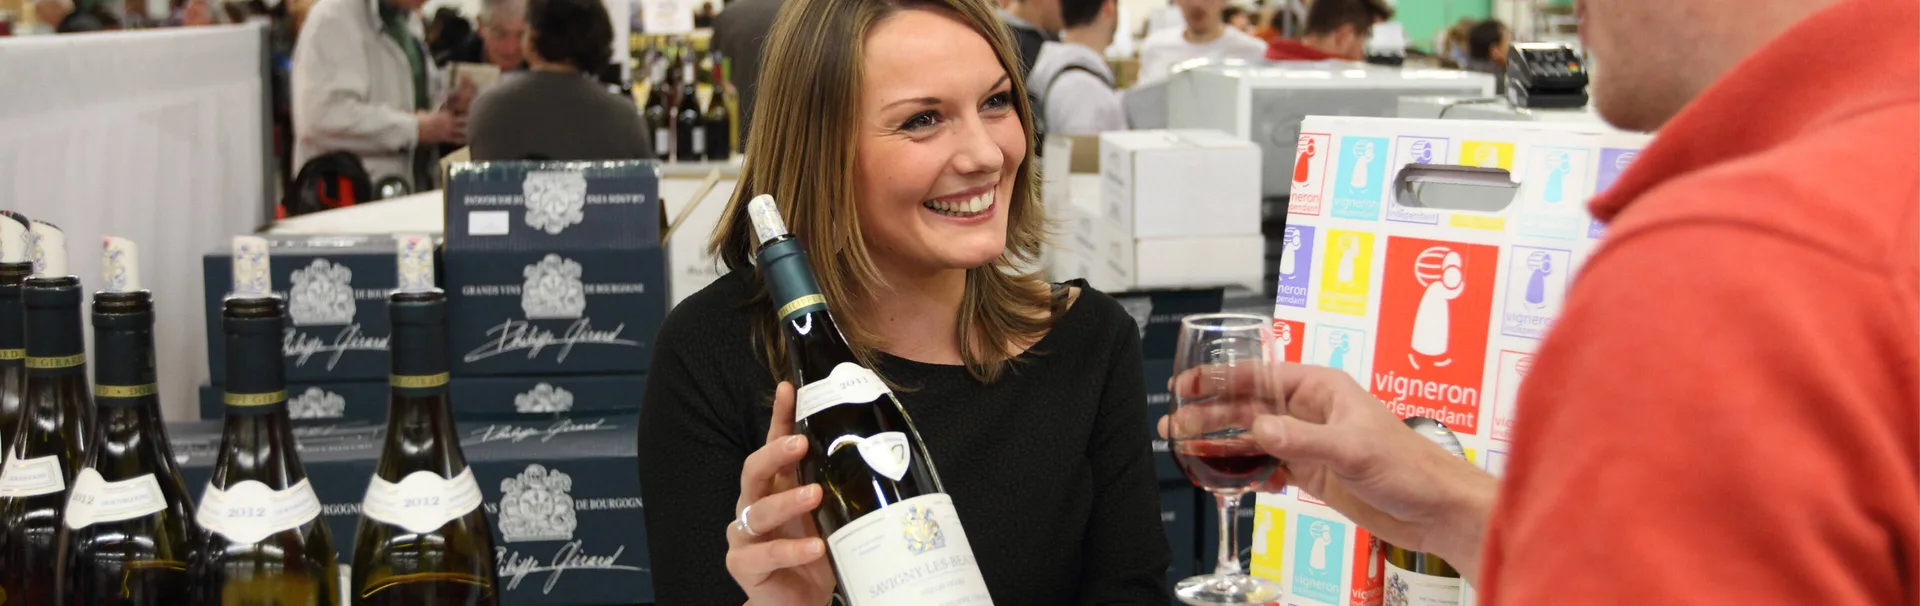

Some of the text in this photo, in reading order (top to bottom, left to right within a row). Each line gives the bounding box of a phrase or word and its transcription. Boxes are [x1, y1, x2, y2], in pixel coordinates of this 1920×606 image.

[1291, 192, 1319, 203] neron
[1290, 203, 1318, 212] pendant
[1277, 283, 1307, 296] neron
[1276, 295, 1305, 306] pendant
[1506, 313, 1552, 328] vignero
[1375, 371, 1476, 406] vigneron
[1380, 397, 1474, 428] dependant
[404, 496, 440, 508] 2012
[576, 499, 588, 511] DE
[590, 496, 643, 510] BOURGOGN
[228, 507, 265, 518] 2012
[323, 502, 362, 516] RGOGN
[1294, 573, 1339, 593] vigneron
